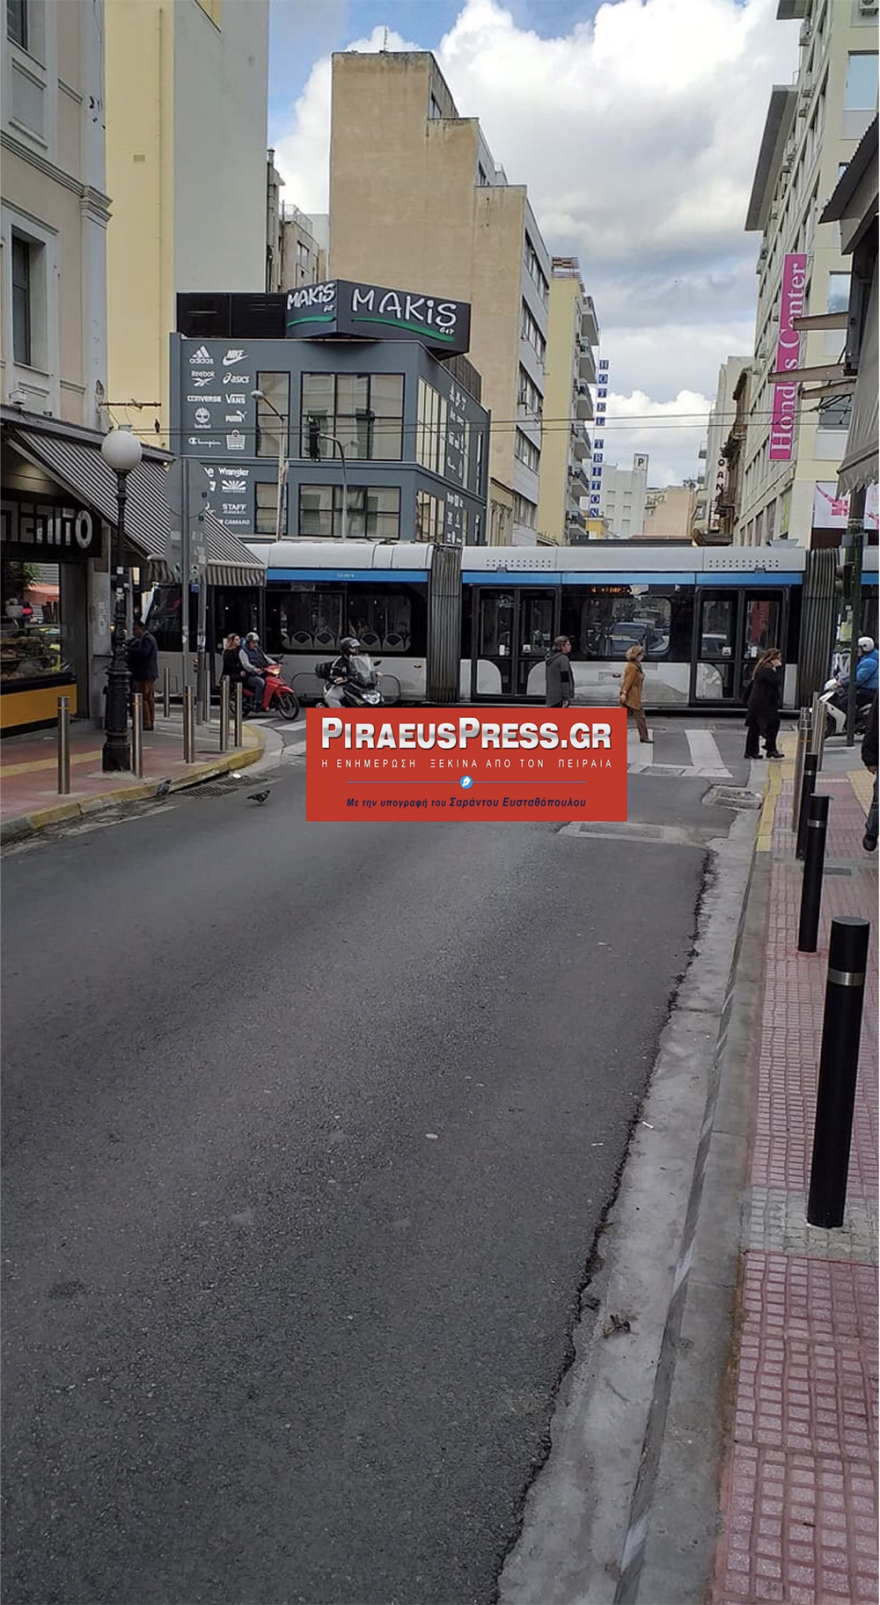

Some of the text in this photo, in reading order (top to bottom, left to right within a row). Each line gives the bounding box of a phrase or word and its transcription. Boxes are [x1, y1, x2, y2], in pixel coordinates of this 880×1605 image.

[191, 370, 216, 378] Reebok
[187, 395, 222, 403] CONVERSE
[225, 393, 246, 405] VANS
[770, 358, 799, 451] Honds
[225, 415, 242, 423] PUMA
[188, 437, 222, 448] Champion
[590, 360, 609, 517] HOTEL TRITON
[218, 467, 249, 478] Wrangler
